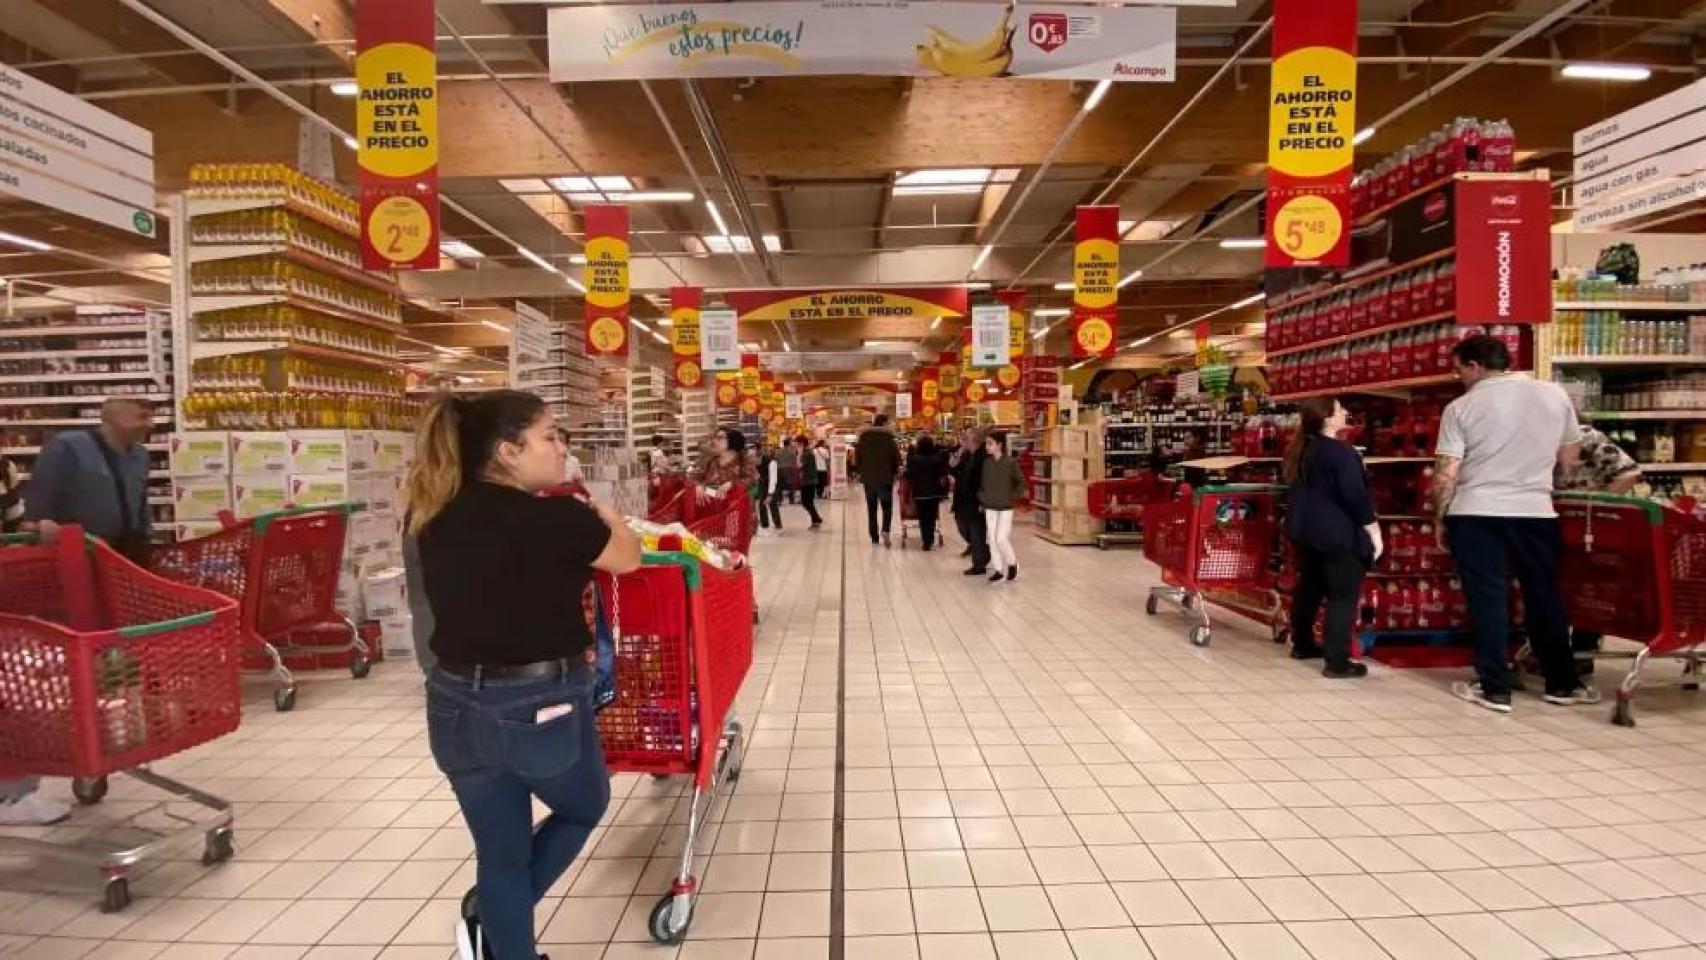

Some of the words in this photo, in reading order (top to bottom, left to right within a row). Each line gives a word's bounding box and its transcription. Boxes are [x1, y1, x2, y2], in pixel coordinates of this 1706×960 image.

[1113, 62, 1166, 76] Alcampo
[386, 71, 408, 84] EL
[1303, 75, 1325, 87] EL
[361, 87, 433, 100] AHORRO
[1274, 89, 1353, 104] AHORRO
[374, 102, 419, 116] ESTÁ
[1289, 104, 1337, 119] ESTÁ
[23, 115, 87, 149] cocinados
[373, 120, 396, 132] EN
[401, 120, 423, 131] EL
[1287, 122, 1311, 134] EN
[1316, 121, 1338, 133] EL
[367, 136, 429, 149] PRECIO
[1279, 136, 1344, 150] PRECIO
[1581, 155, 1608, 171] agua
[1581, 182, 1608, 198] agua
[1611, 174, 1633, 187] con
[1636, 166, 1658, 181] gas
[1580, 204, 1625, 223] cerveza
[1627, 198, 1647, 210] sin
[1648, 180, 1697, 204] alcohol
[1496, 231, 1510, 317] PROMOCIÓN
[810, 296, 826, 305] EL
[830, 295, 884, 304] AHORRO
[827, 307, 843, 317] EN
[848, 307, 863, 316] EL
[868, 306, 913, 316] PRECIO
